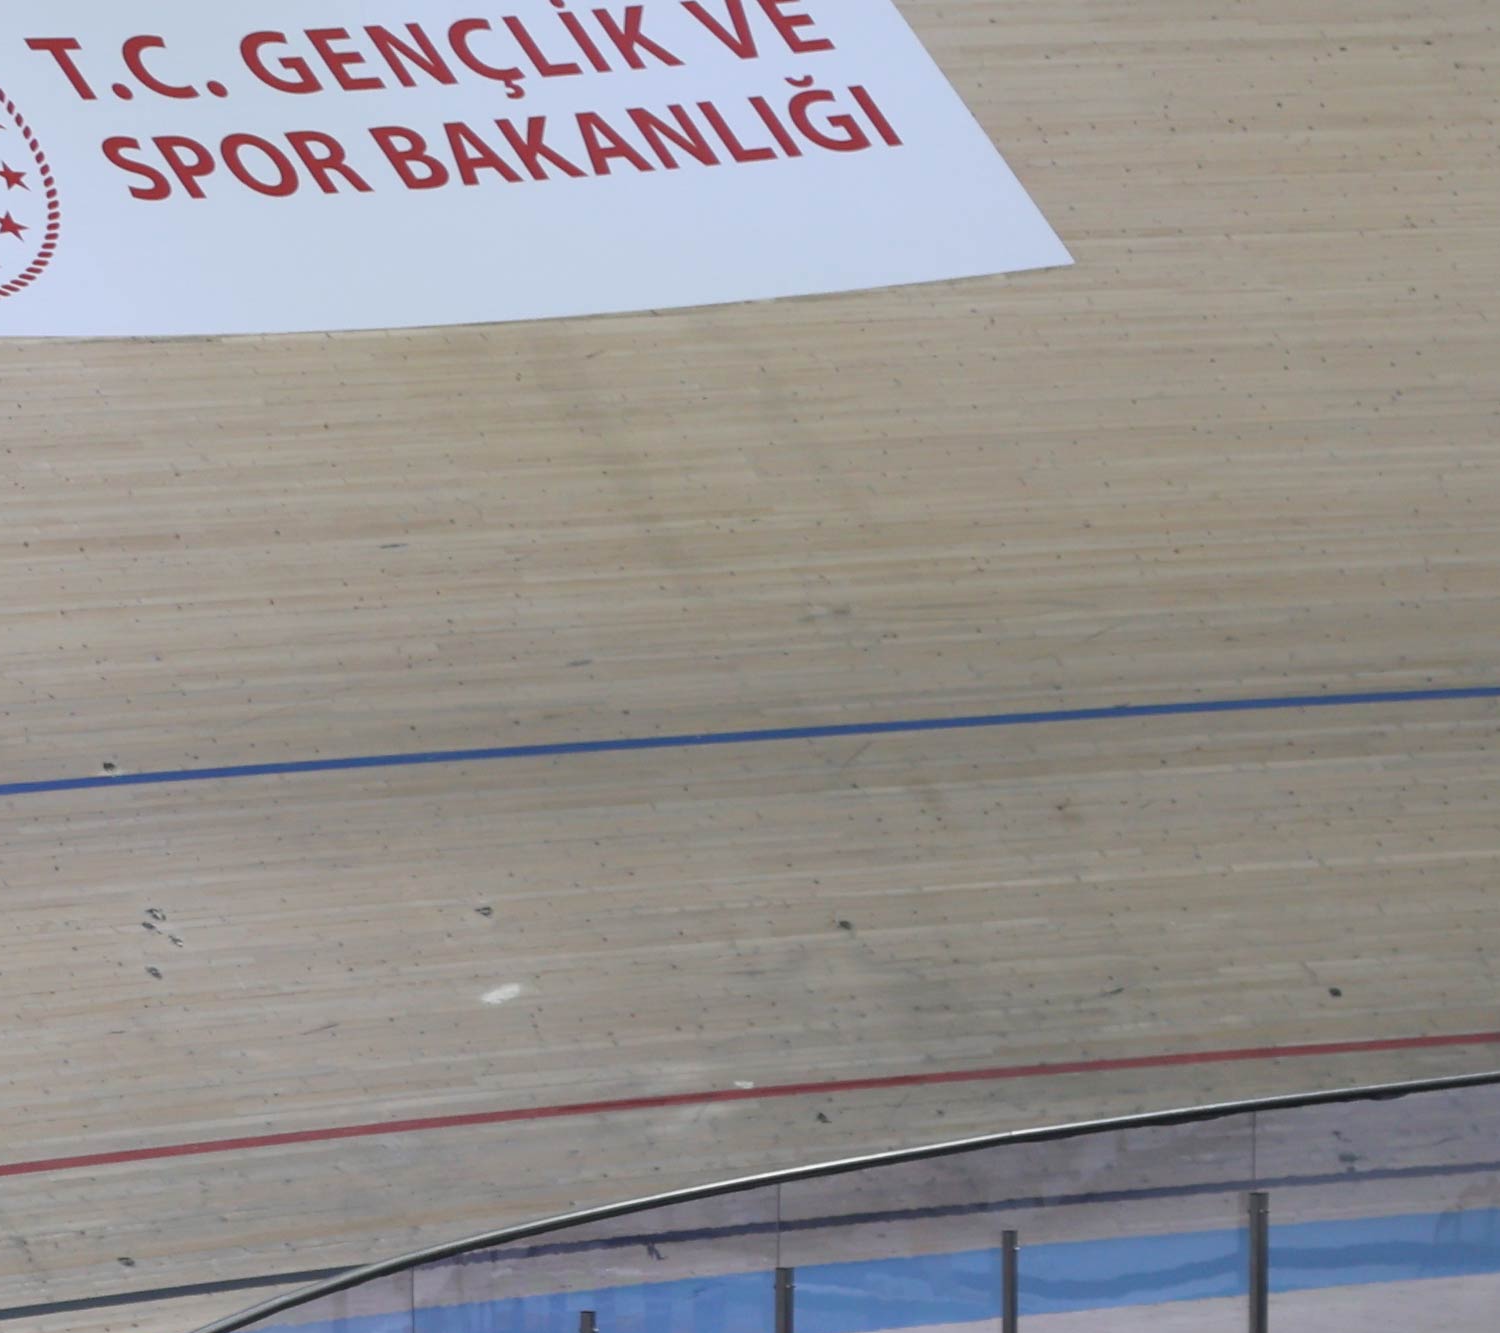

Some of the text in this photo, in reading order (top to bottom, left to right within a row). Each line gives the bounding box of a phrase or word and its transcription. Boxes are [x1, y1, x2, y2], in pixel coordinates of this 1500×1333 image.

[27, 0, 836, 100] T.C. GENÇLİK VE
[102, 76, 902, 200] SPOR BAKANLIĞI
